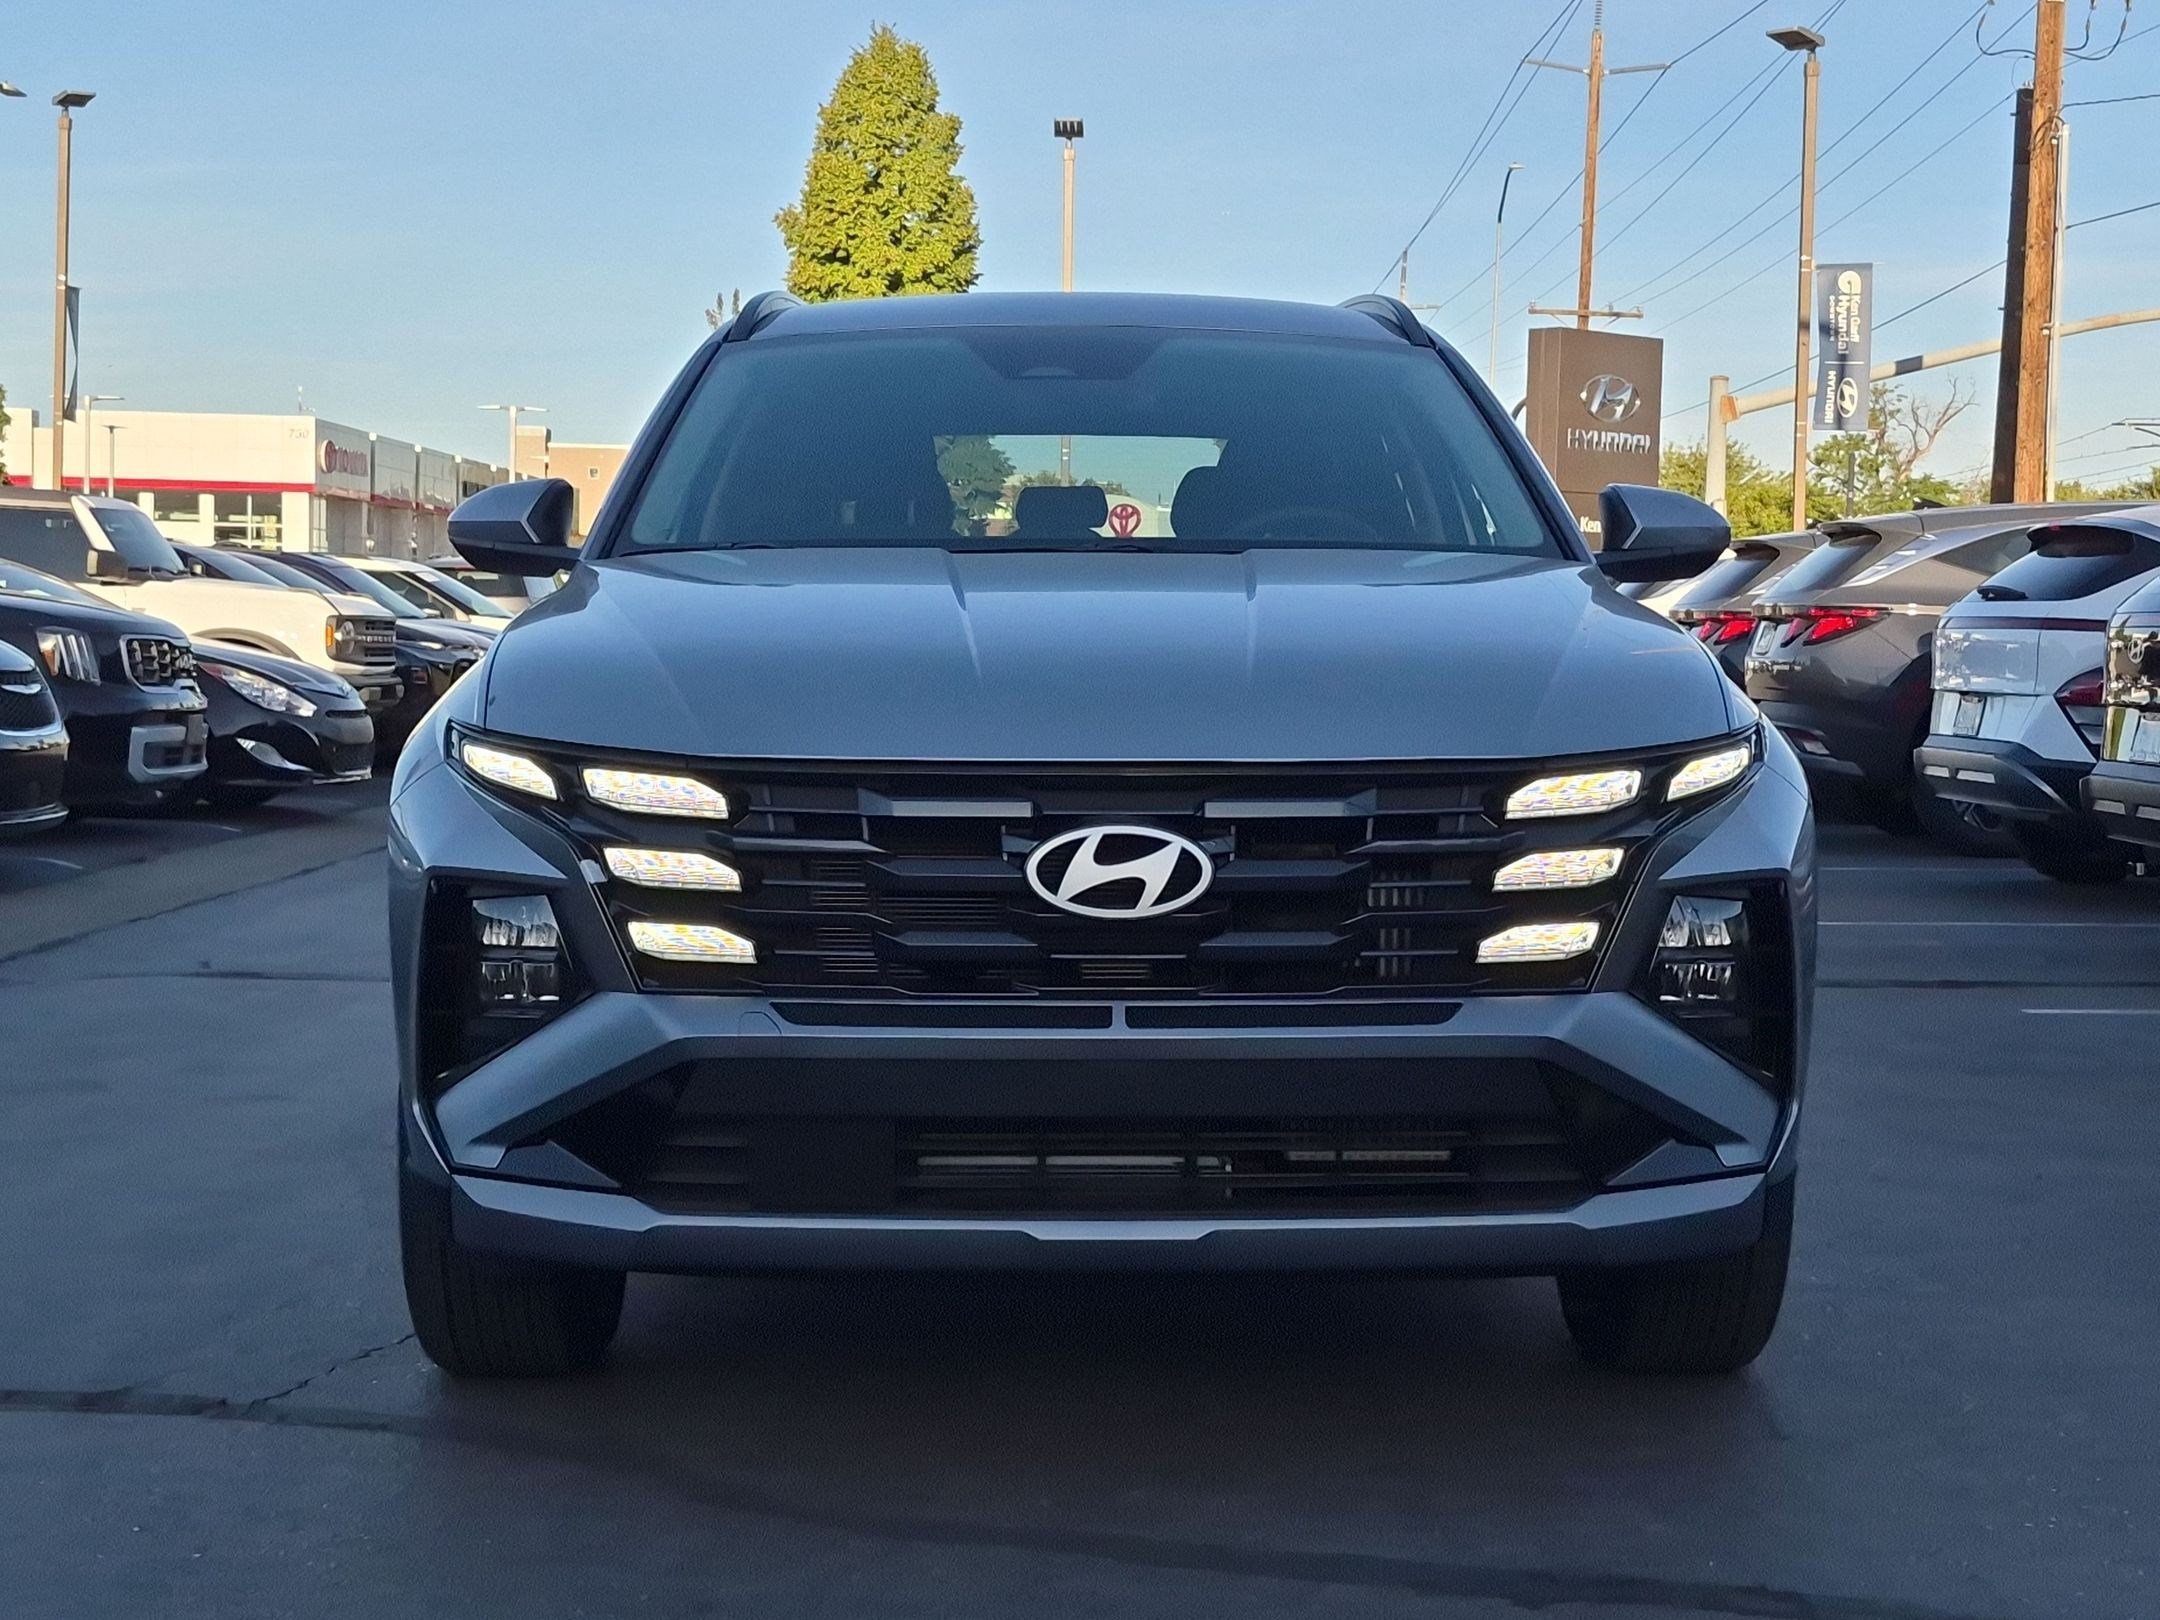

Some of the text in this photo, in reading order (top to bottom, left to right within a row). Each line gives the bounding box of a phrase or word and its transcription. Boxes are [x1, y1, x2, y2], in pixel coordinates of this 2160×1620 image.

[1836, 294, 1850, 354] Hyundai
[1824, 370, 1837, 424] HYUNDAI
[1567, 427, 1651, 455] HYUNDAI
